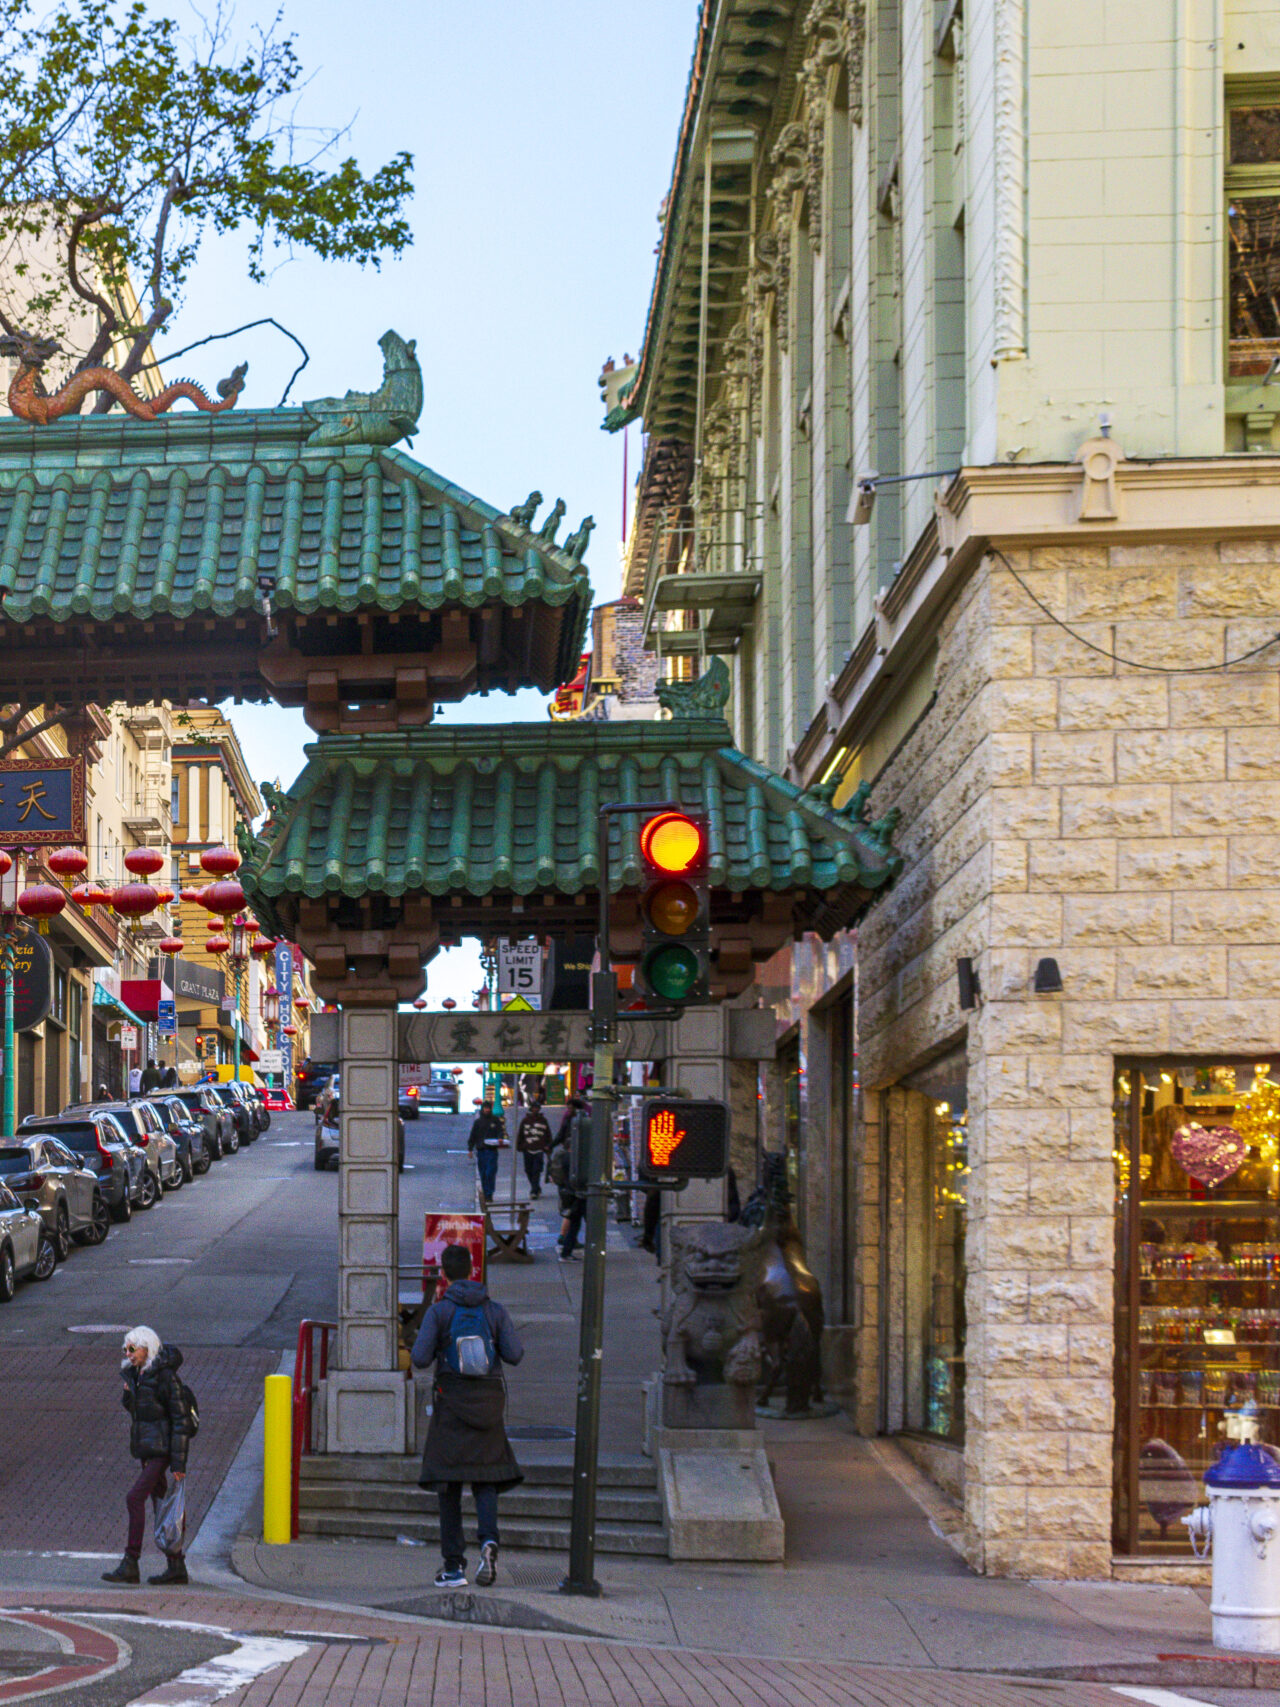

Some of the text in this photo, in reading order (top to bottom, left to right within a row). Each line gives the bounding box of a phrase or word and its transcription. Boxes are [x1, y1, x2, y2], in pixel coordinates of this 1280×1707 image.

[501, 945, 539, 954] SPEED
[505, 956, 535, 965] LIMIT
[279, 951, 290, 991] CITY
[508, 967, 534, 988] 15
[180, 980, 220, 1001] GRANT PLAZA
[401, 1064, 422, 1074] TIME
